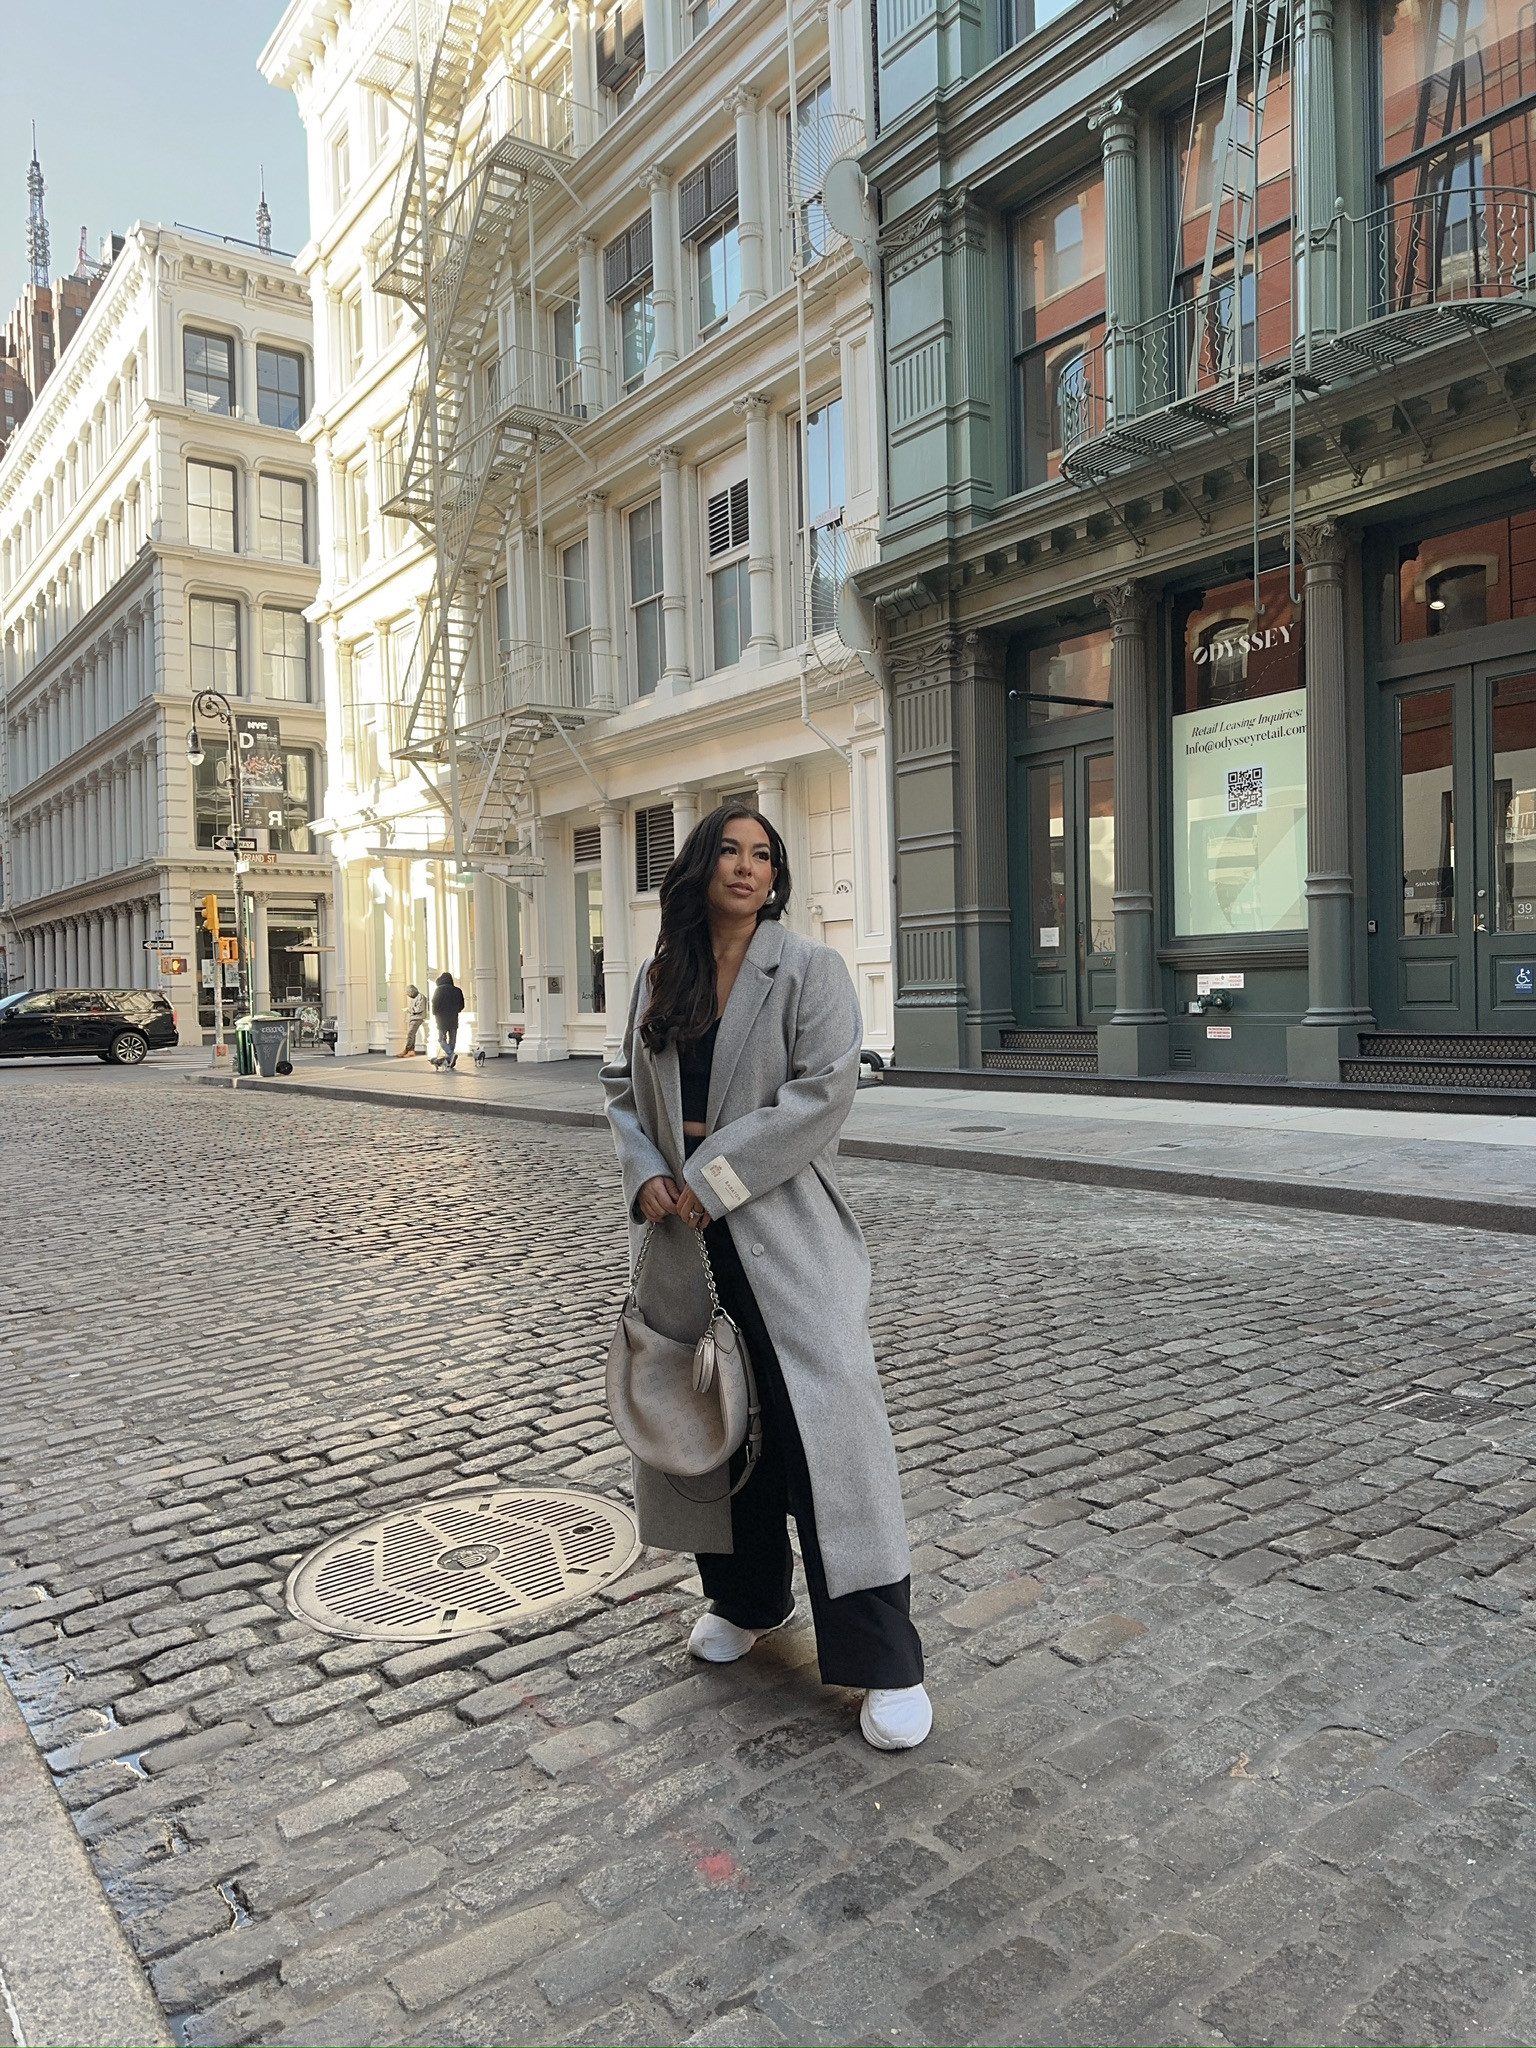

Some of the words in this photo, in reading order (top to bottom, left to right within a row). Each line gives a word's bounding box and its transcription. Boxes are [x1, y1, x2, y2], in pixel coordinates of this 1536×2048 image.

[1193, 623, 1294, 665] ODYSSEY
[247, 721, 268, 730] NYC
[1191, 722, 1219, 737] Retail
[1219, 717, 1256, 732] Leasing
[1258, 708, 1304, 726] Inquiries:
[239, 732, 255, 749] D
[243, 853, 265, 863] GRAND
[267, 854, 276, 864] ST
[1517, 903, 1533, 914] 39
